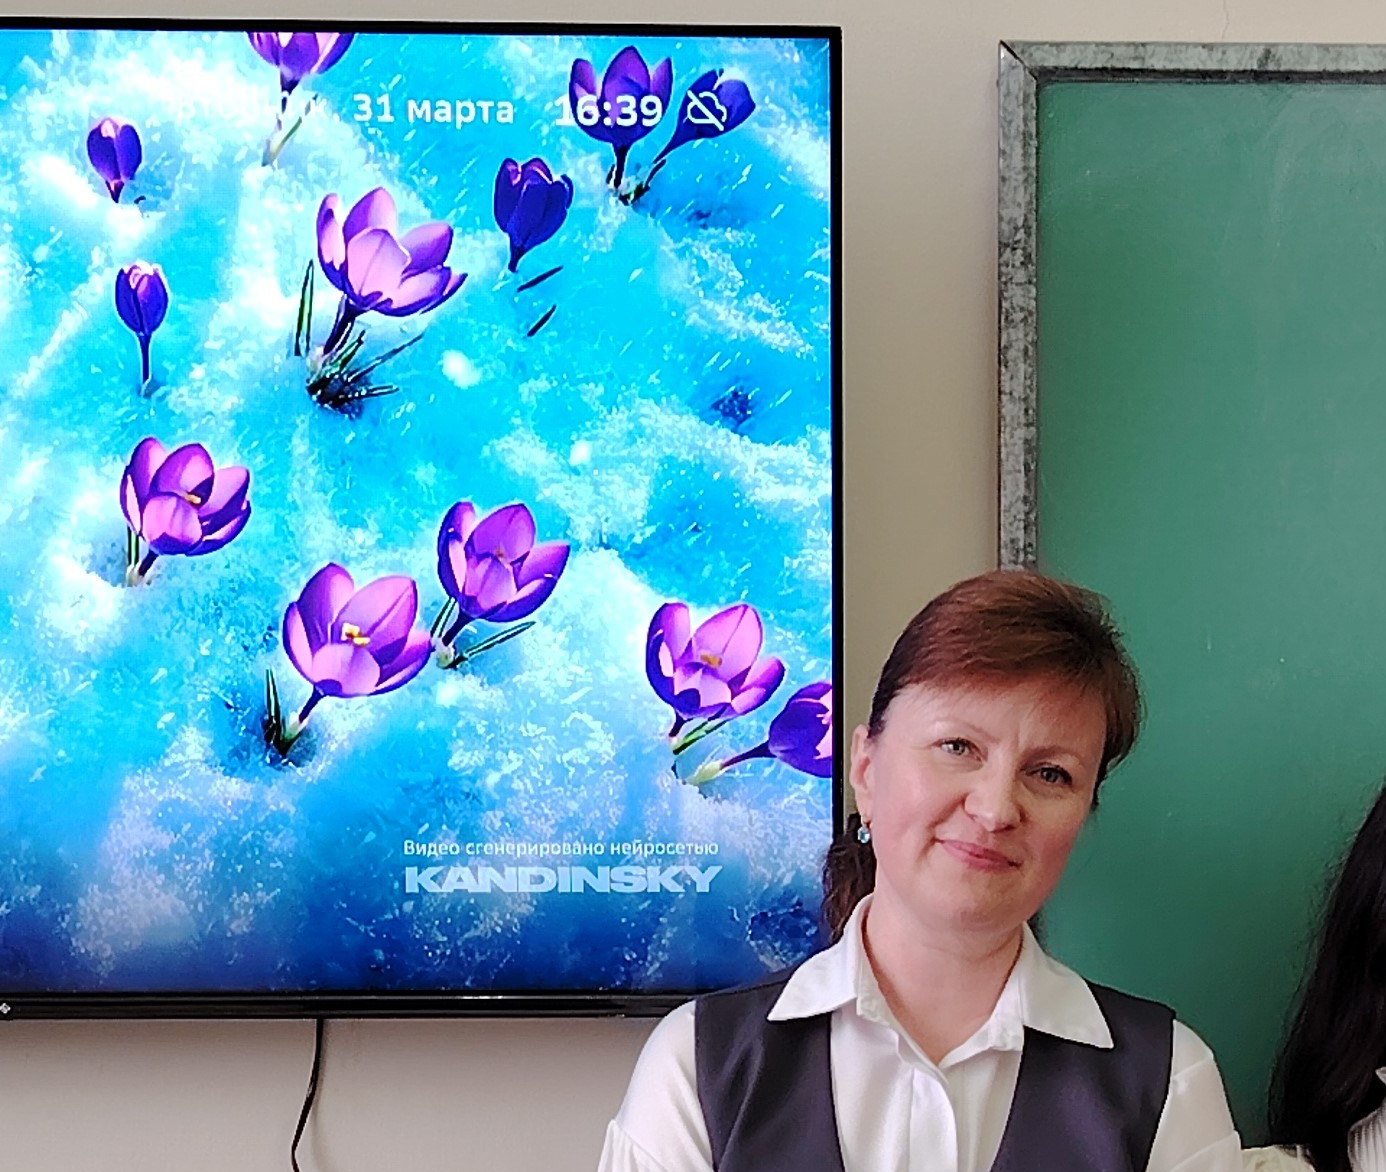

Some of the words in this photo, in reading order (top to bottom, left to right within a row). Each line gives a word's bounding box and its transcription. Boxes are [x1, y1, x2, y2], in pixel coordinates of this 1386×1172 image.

[353, 93, 394, 122] 31
[407, 99, 514, 129] марта
[555, 95, 663, 126] 16:39
[404, 840, 459, 856] Видео
[466, 842, 604, 857] сгенерировано
[611, 841, 718, 856] нейросетью
[406, 866, 722, 893] KANDINSKY
